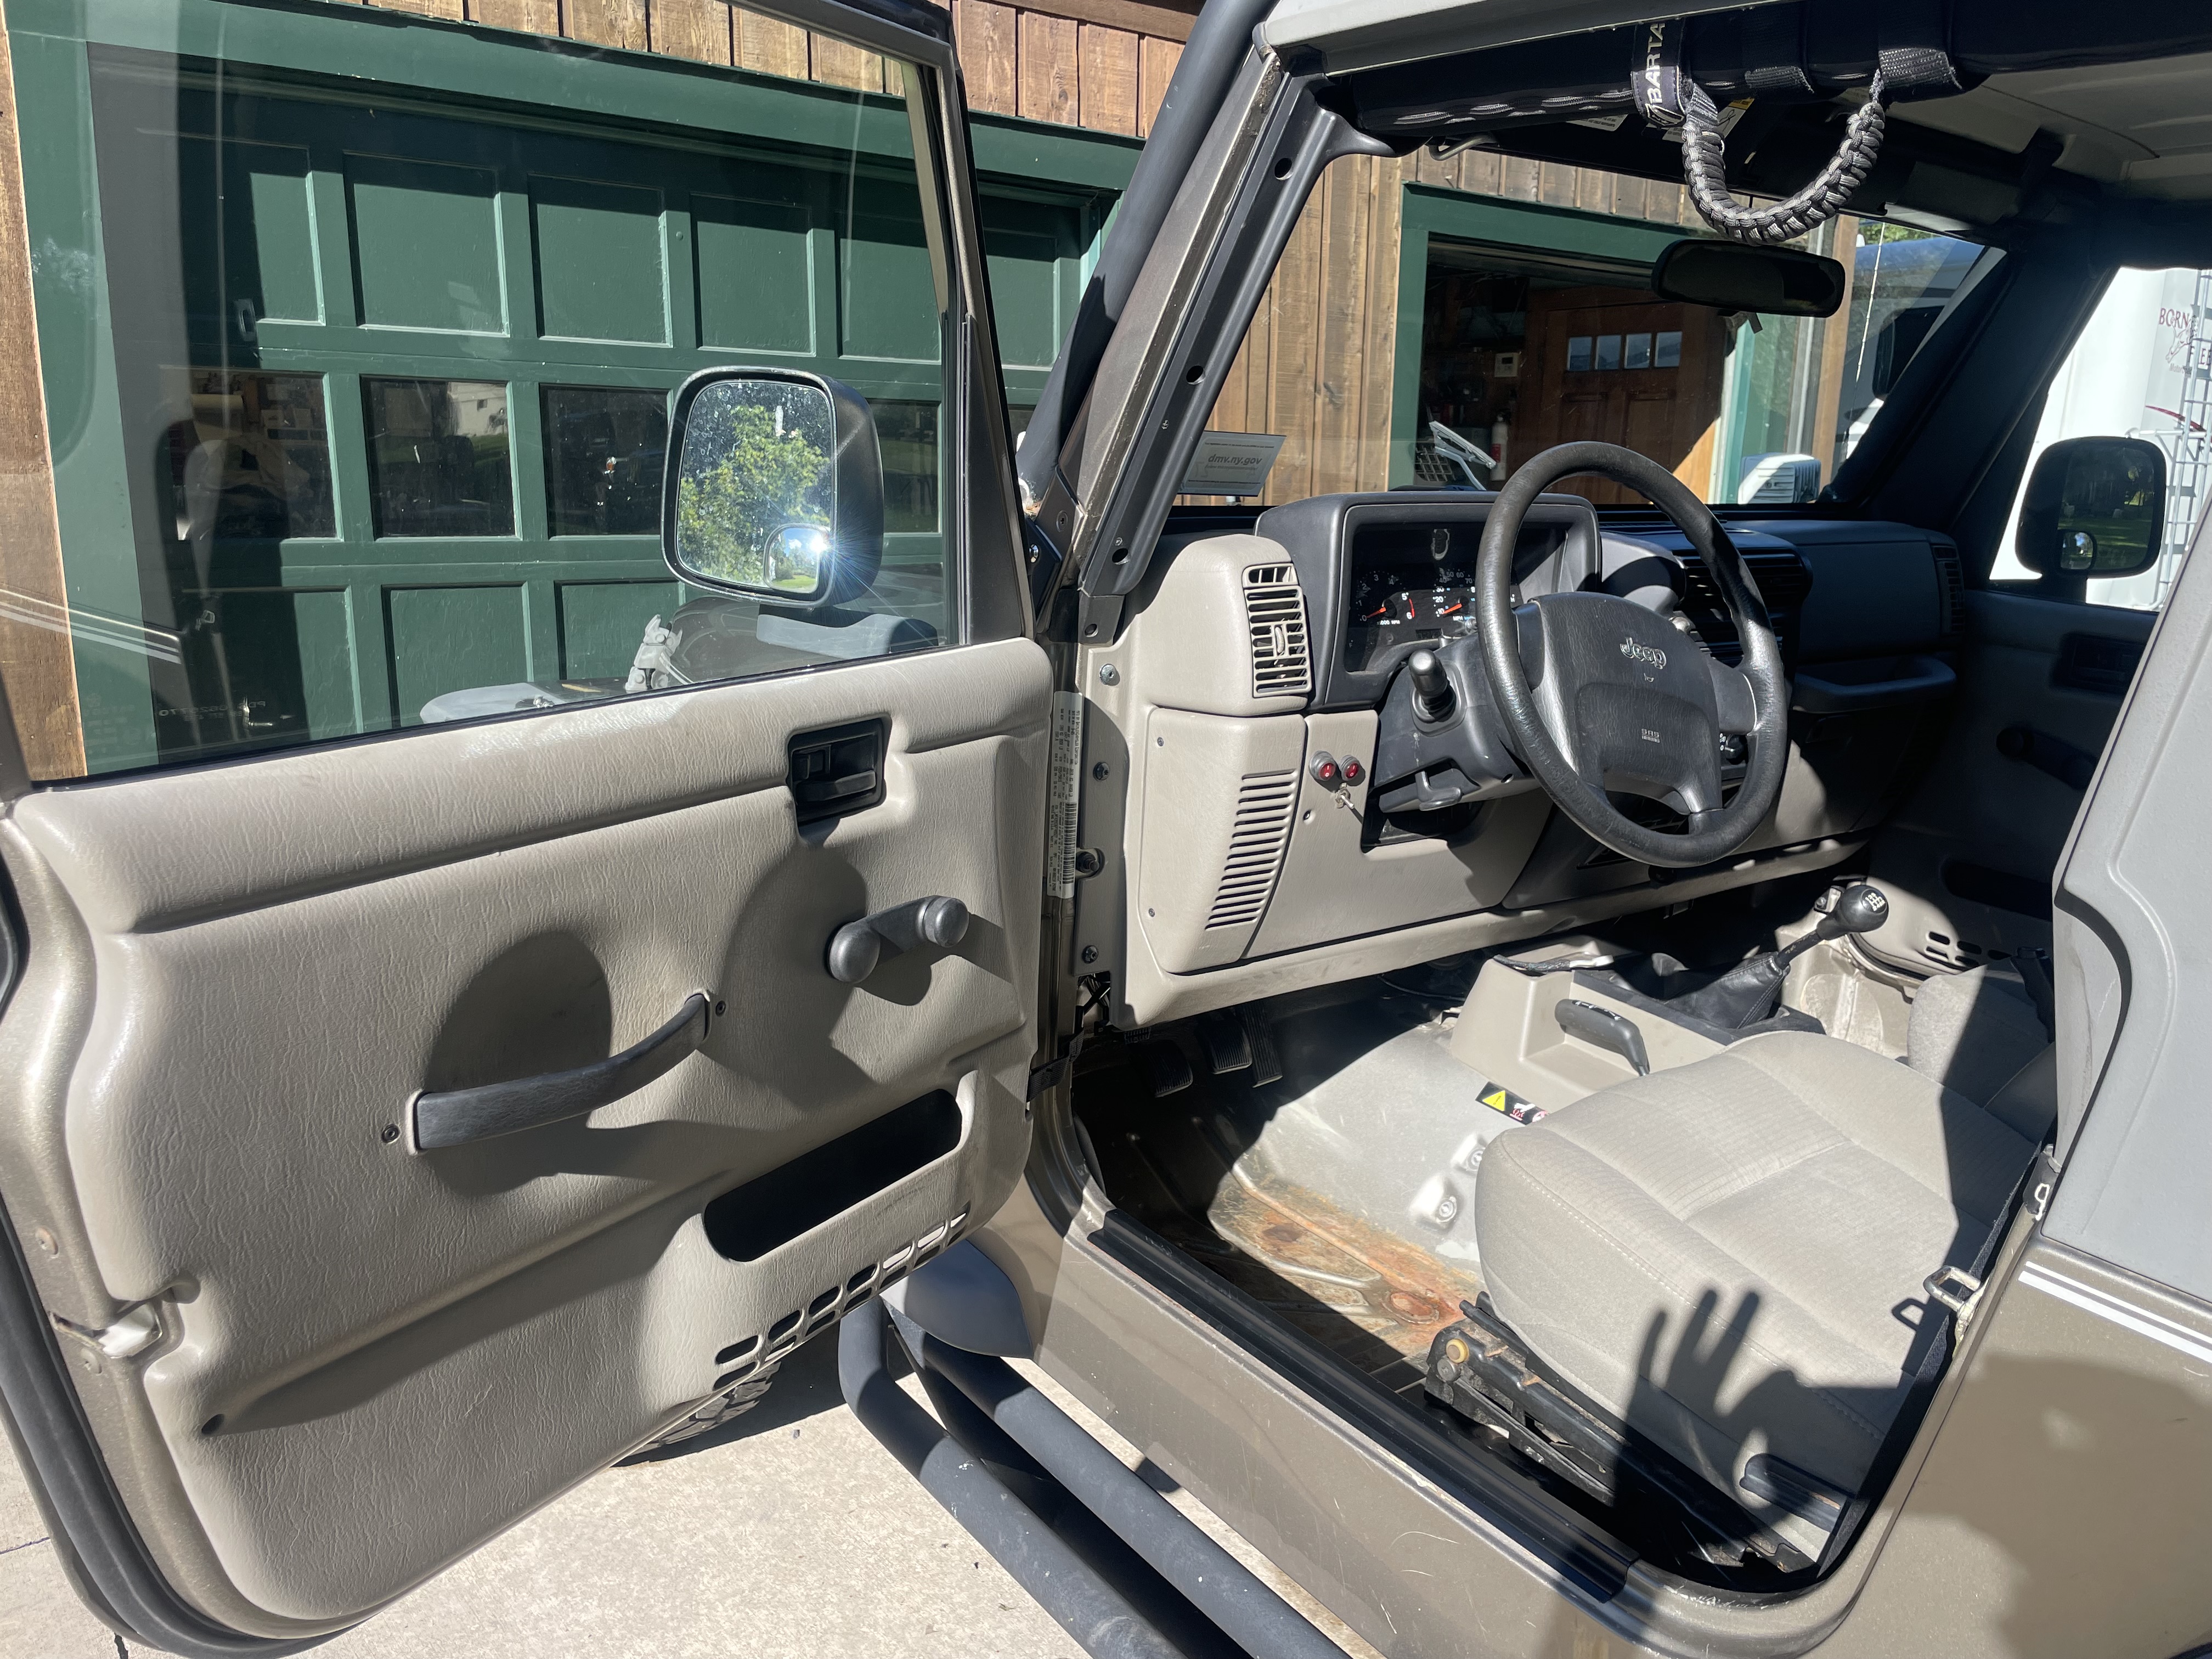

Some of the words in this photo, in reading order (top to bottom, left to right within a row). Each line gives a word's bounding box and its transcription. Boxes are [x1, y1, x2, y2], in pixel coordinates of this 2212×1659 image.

[1646, 22, 1666, 104] BARTA
[2159, 307, 2190, 329] BORN
[1208, 454, 1262, 465] dmv.ny.gov
[1620, 637, 1667, 670] Jeep
